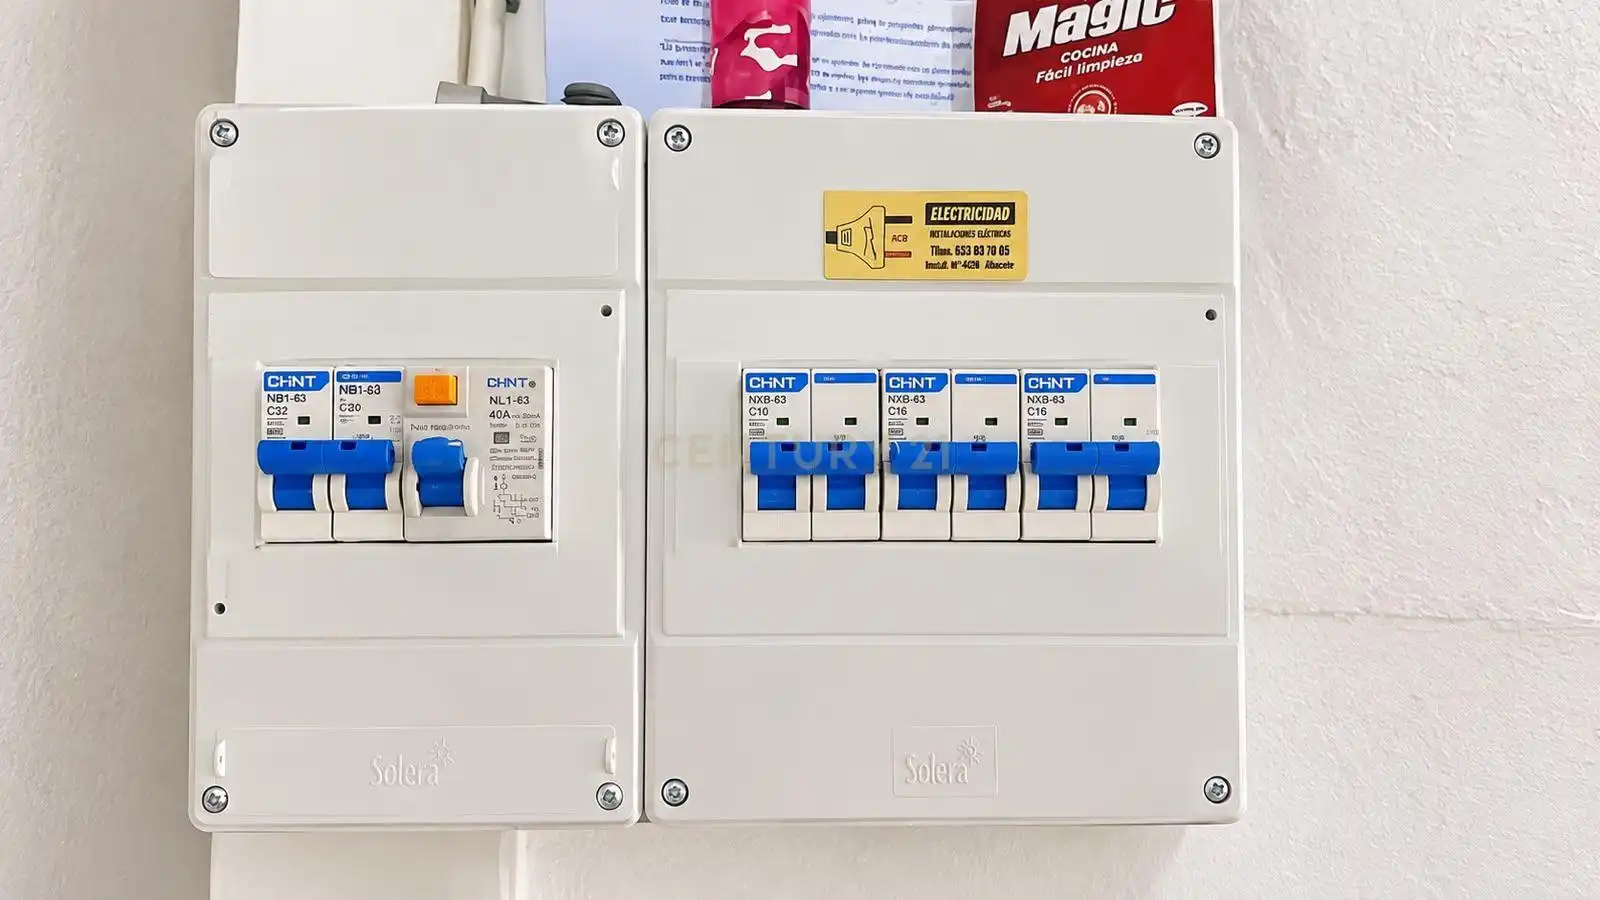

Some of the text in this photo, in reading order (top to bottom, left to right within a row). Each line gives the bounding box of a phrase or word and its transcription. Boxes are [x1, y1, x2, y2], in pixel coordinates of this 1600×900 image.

[1003, 0, 1175, 56] Magic
[1061, 42, 1118, 63] COCINA
[1036, 52, 1143, 84] Fácil limpieza
[930, 206, 1010, 221] ELECTRICIDAD
[955, 245, 971, 256] 653
[986, 245, 997, 256] 70
[999, 245, 1010, 256] 05
[267, 394, 307, 403] NB1-63
[489, 395, 530, 405] NL1-63
[749, 395, 787, 404] NXB-63
[888, 394, 926, 404] NXB-63
[1027, 395, 1065, 404] NXB-63
[267, 406, 288, 416] C32
[489, 410, 511, 419] 40A
[749, 407, 769, 416] C10
[888, 406, 908, 416] C16
[1027, 407, 1047, 416] C16
[369, 753, 441, 787] Solera
[905, 752, 969, 784] Solera
